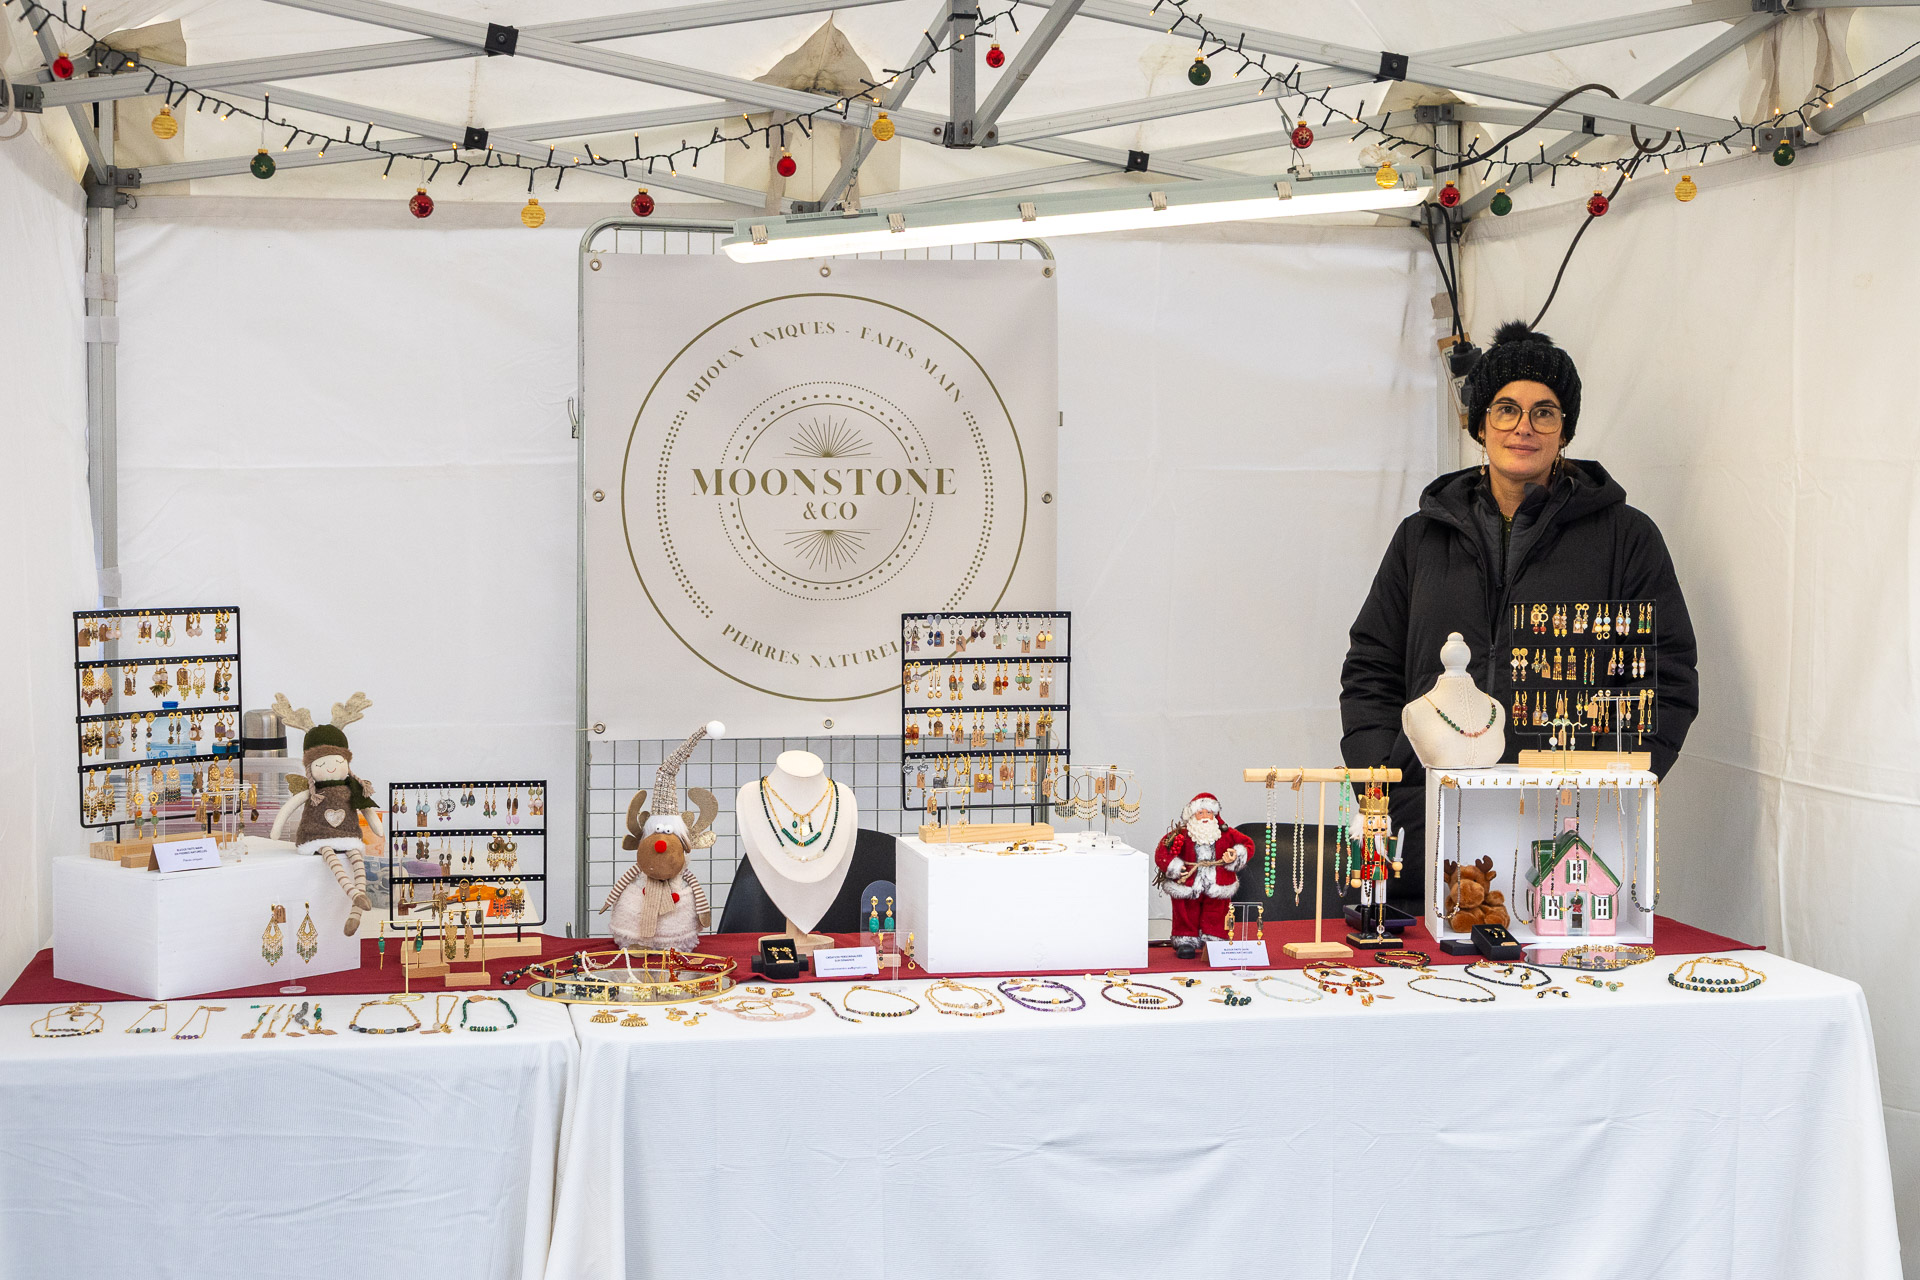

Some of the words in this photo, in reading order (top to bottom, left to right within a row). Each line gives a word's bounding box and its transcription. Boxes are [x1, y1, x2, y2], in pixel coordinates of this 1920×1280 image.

[685, 345, 745, 403] BIJOUX
[749, 321, 836, 349] UNIQUES
[860, 325, 917, 359] FAITS
[920, 357, 964, 403] MAIN
[690, 467, 958, 496] MOONSTONE
[802, 501, 858, 520] &CO
[721, 623, 800, 666] PIERRES
